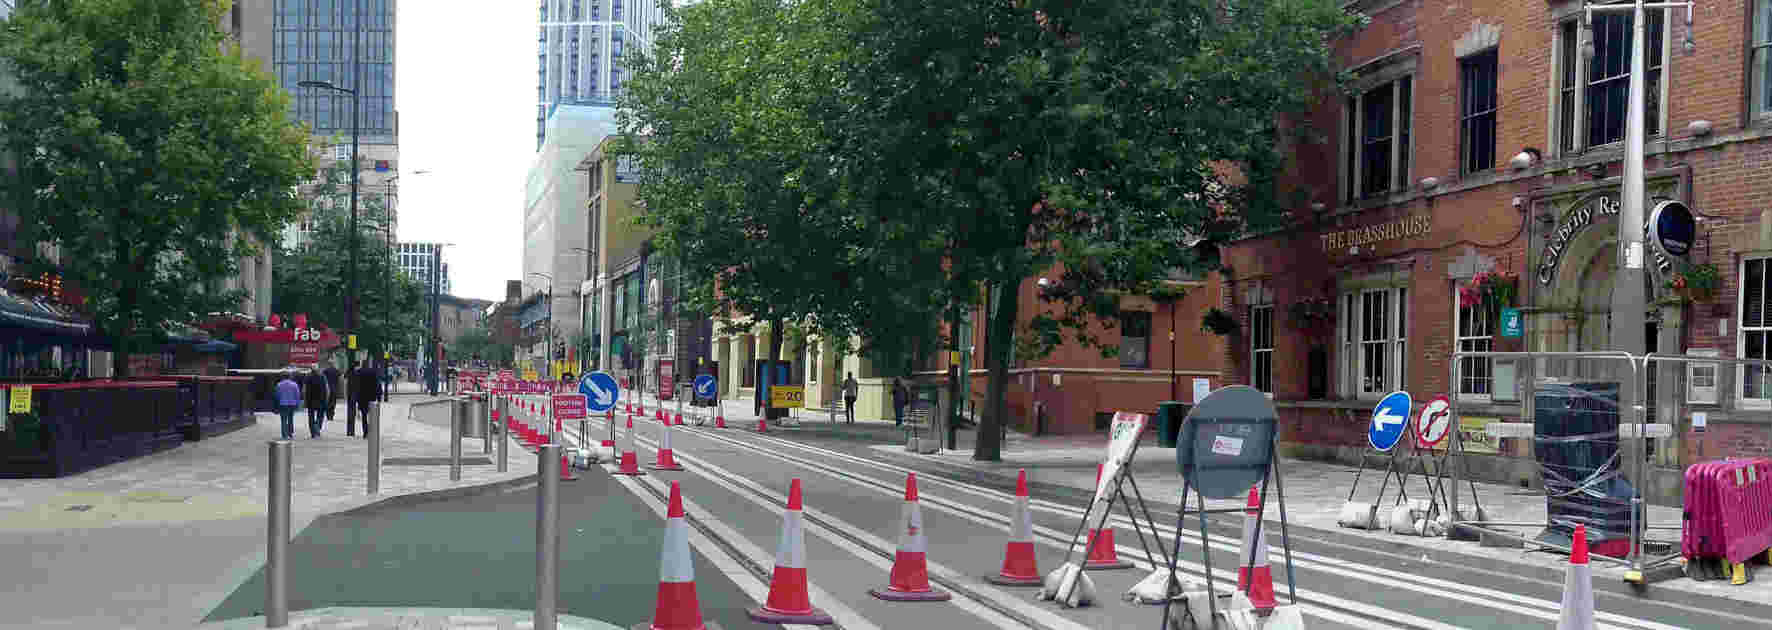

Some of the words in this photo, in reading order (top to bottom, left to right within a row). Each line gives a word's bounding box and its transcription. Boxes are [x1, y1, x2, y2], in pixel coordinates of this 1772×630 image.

[1320, 232, 1344, 253] THE
[1346, 215, 1432, 247] BRASSHOUSE
[1538, 206, 1592, 284] Celebrity
